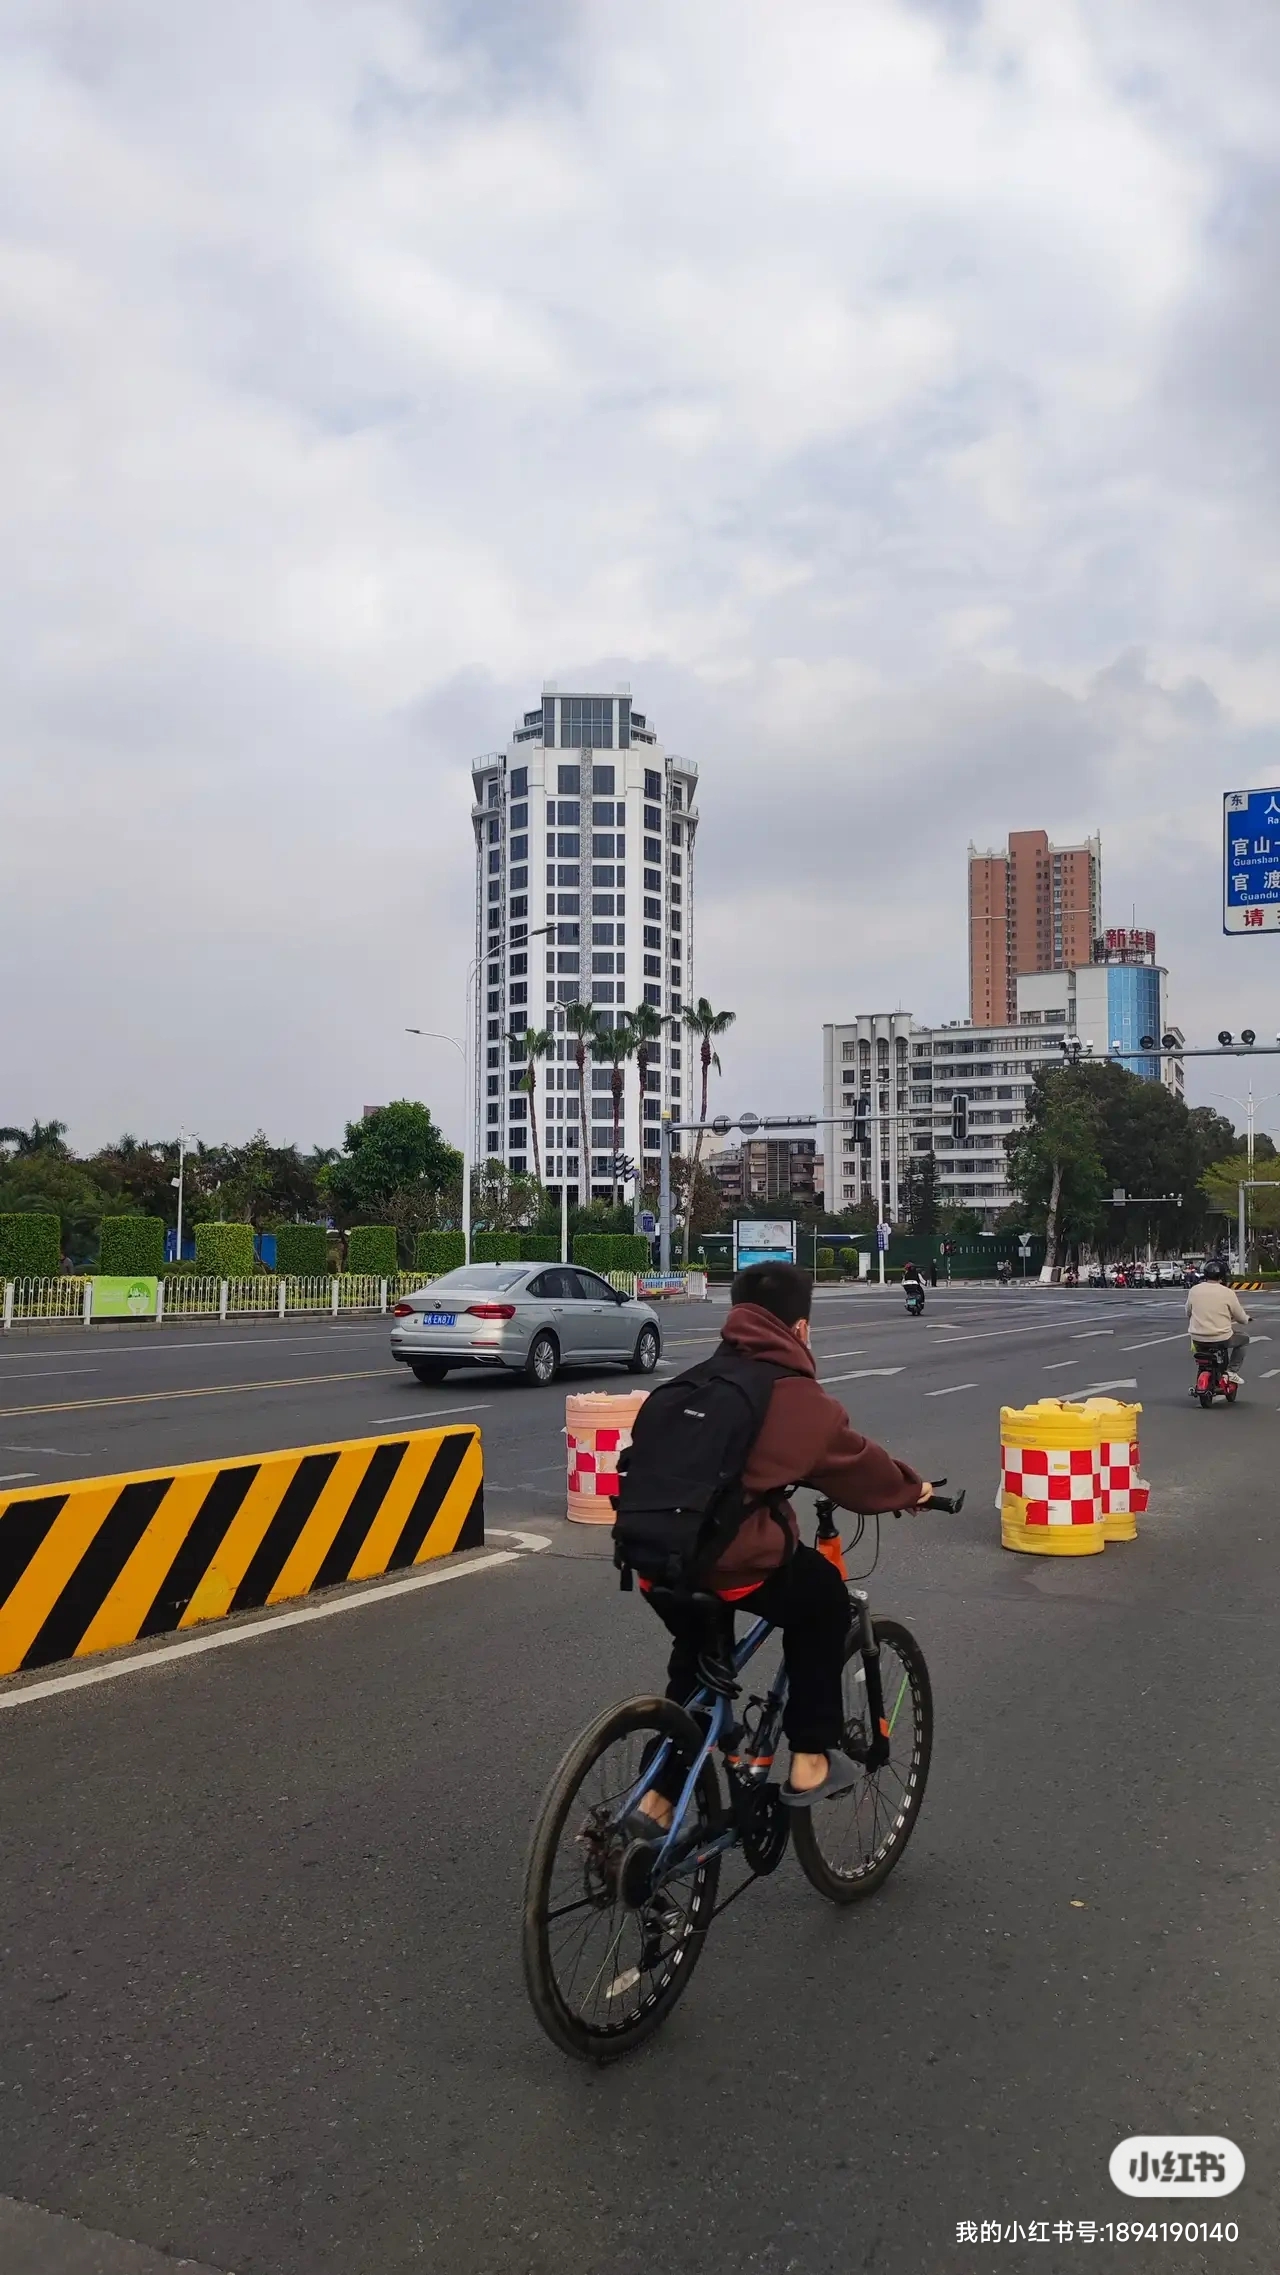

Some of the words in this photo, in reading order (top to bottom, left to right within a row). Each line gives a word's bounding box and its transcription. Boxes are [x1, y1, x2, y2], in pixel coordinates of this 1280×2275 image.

[1231, 795, 1243, 806] 东
[1233, 856, 1279, 867] Guanshan
[1232, 870, 1280, 892] 官渡
[1240, 890, 1279, 901] Guandu
